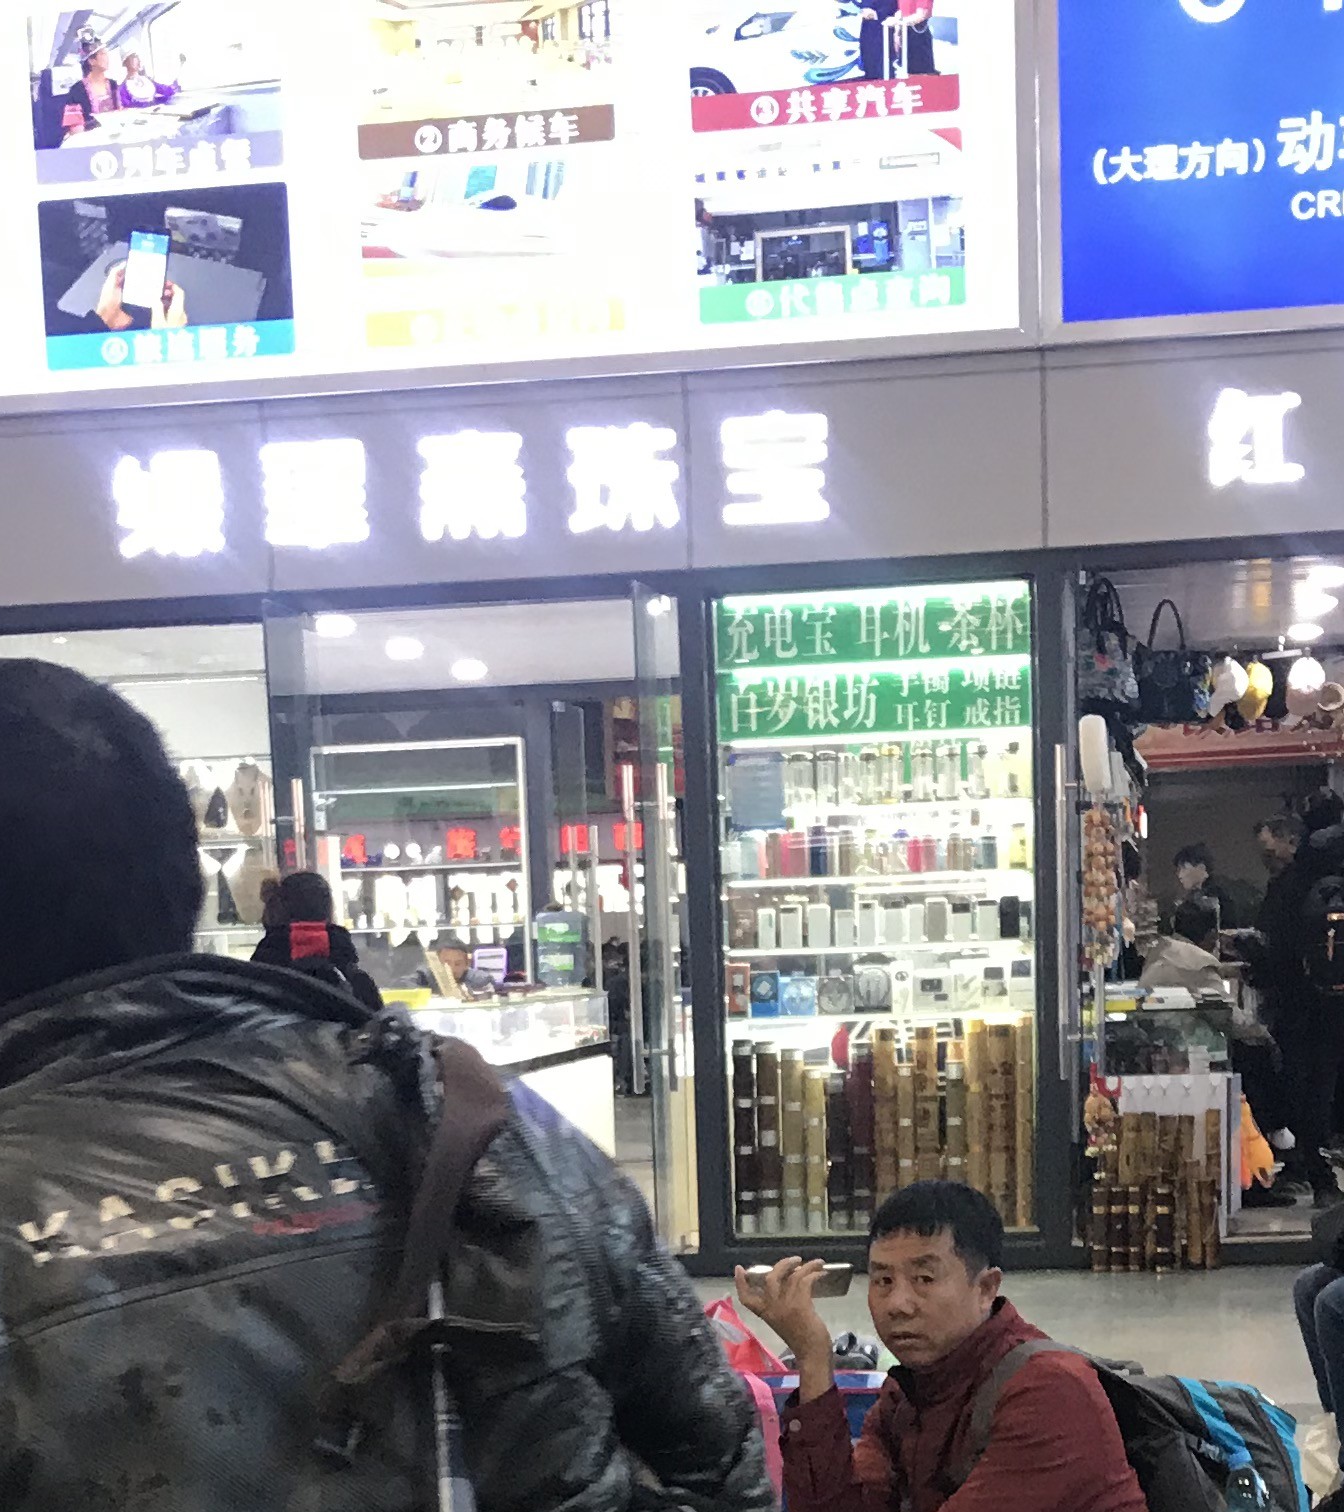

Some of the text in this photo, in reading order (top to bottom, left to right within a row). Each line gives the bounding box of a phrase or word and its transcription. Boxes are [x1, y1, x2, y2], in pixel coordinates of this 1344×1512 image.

[723, 604, 838, 662] 充电宝
[856, 600, 931, 657] 耳机
[894, 695, 1023, 731] 耳钉 戒指
